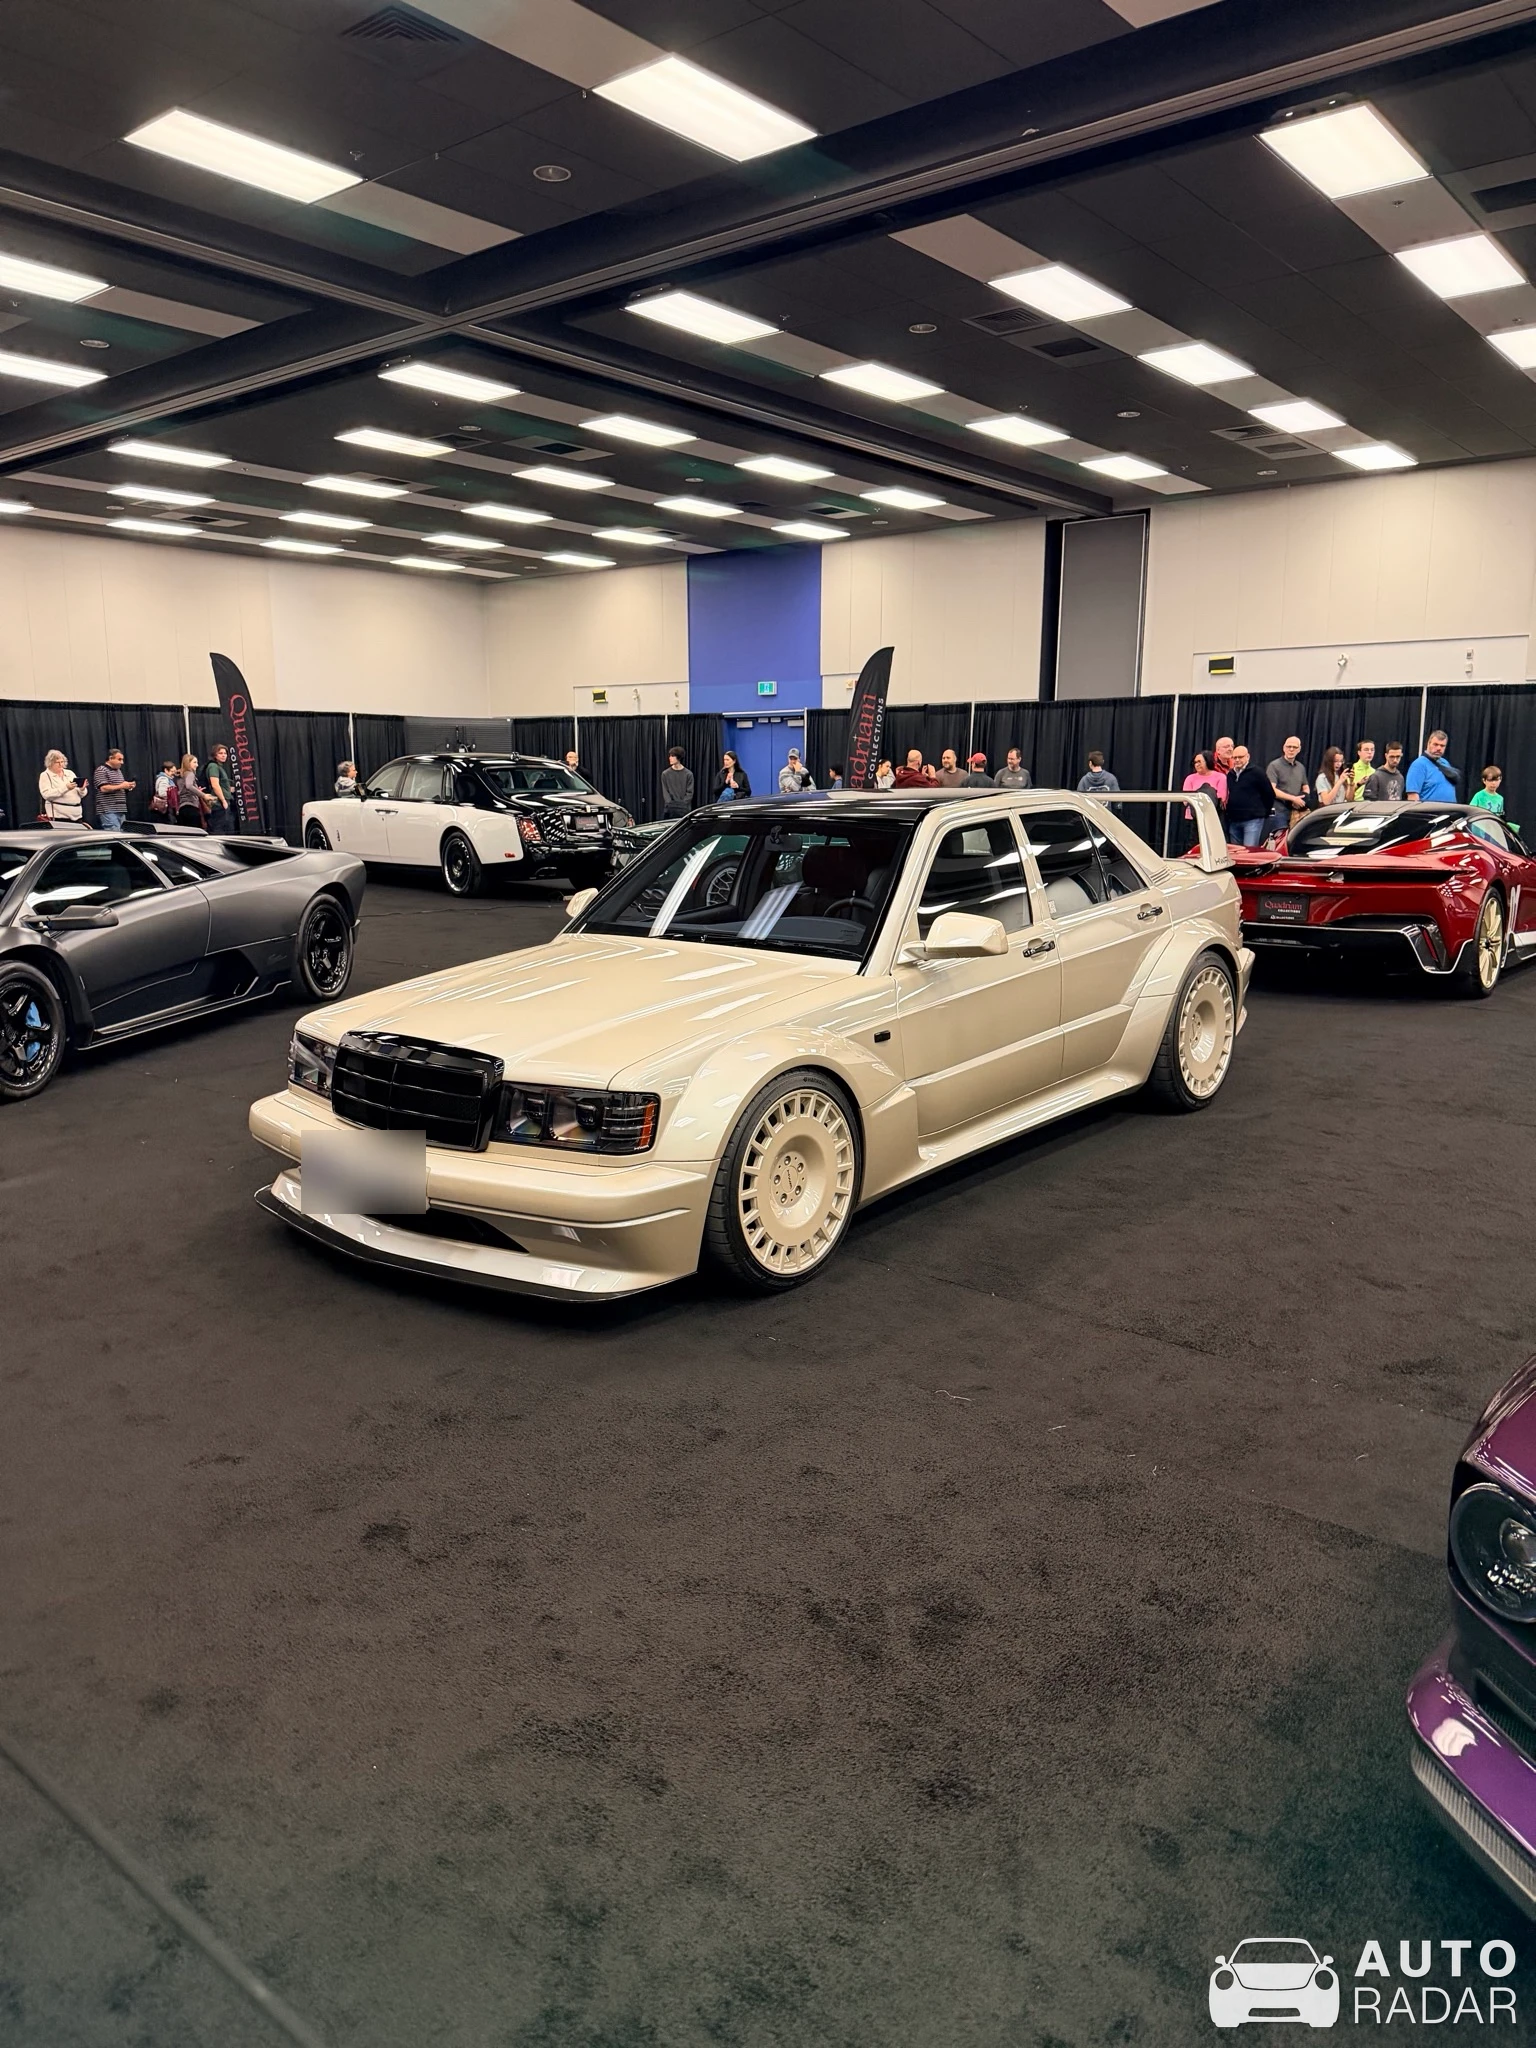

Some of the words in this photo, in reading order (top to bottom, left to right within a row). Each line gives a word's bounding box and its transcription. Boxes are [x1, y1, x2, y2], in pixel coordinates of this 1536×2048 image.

[229, 694, 260, 821] Quadriam
[849, 693, 877, 789] adriam
[867, 698, 884, 780] COLLECTIONS
[230, 747, 247, 821] COLLECTIONS
